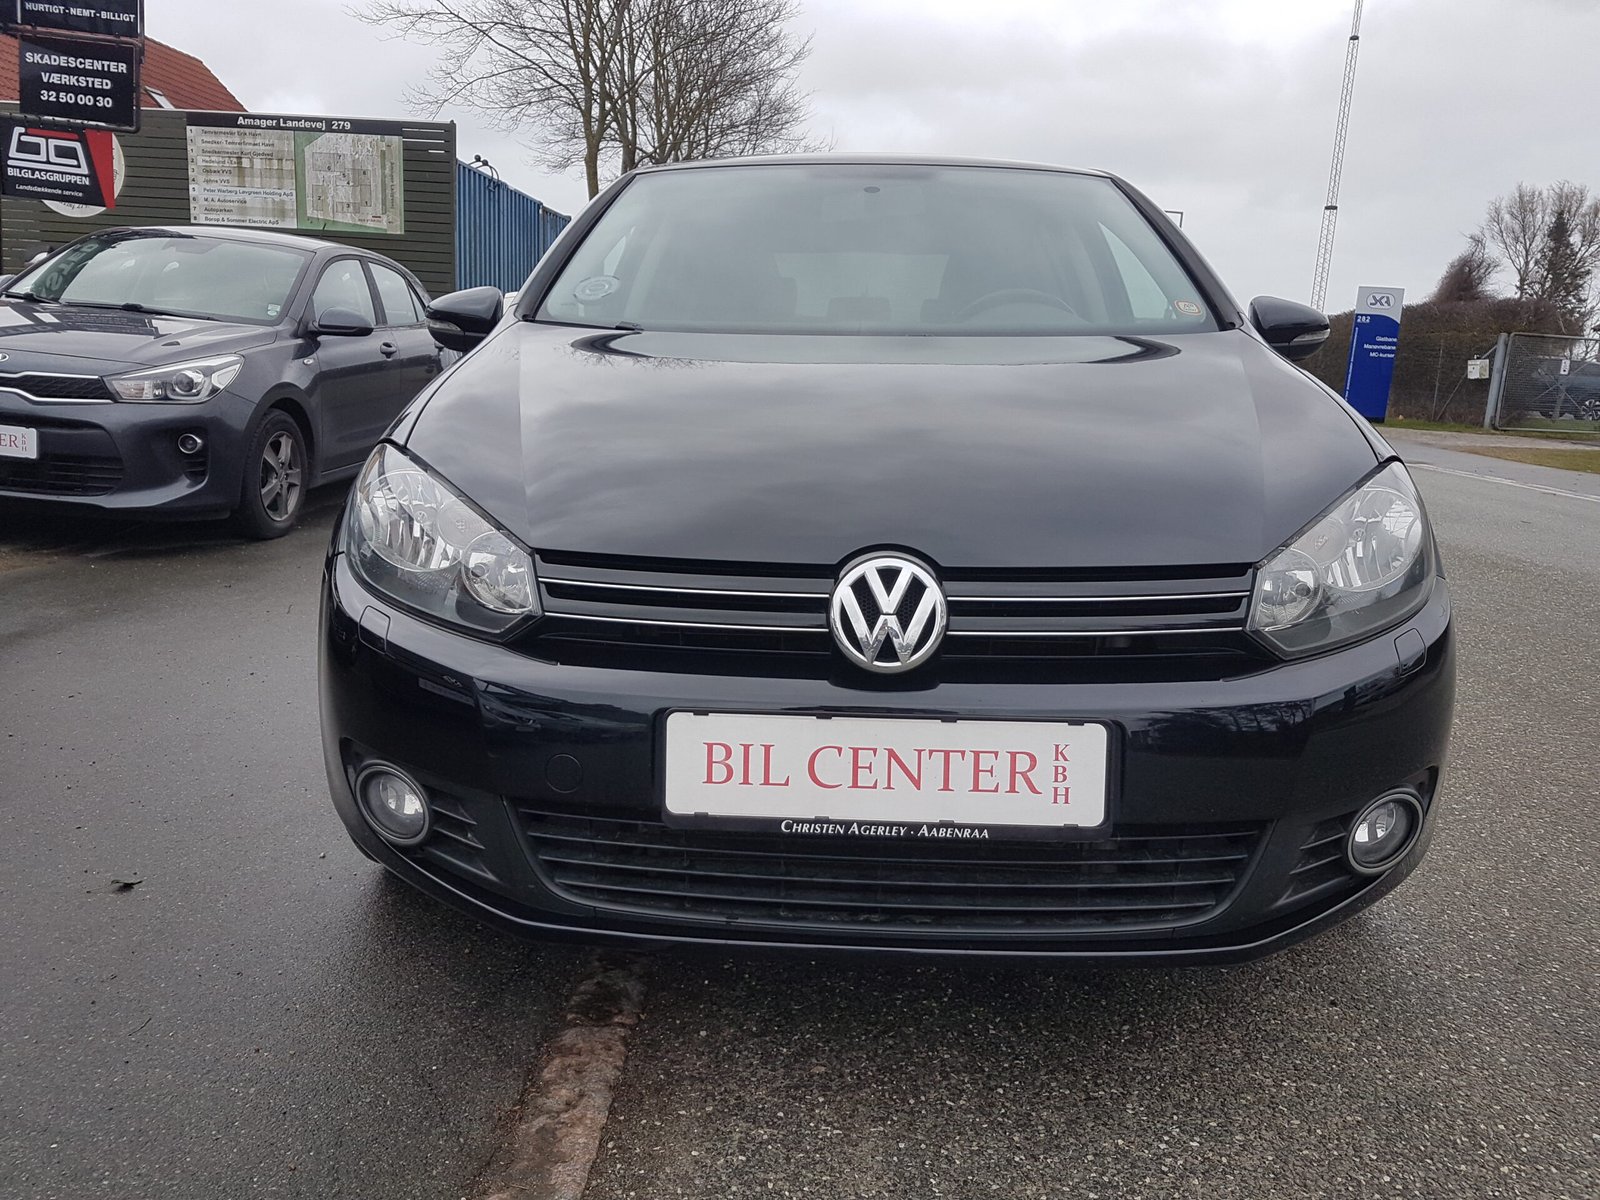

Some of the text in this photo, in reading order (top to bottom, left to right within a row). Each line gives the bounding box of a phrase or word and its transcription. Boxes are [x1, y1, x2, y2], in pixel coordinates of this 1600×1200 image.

[70, 8, 96, 18] NEMT
[101, 11, 135, 22] BILLIGT
[25, 52, 127, 73] SKADESCENTER
[41, 72, 111, 89] VÆRKSTED
[40, 90, 112, 108] 32 50 00 30
[237, 116, 350, 130] Amager Landevej 279
[7, 167, 90, 186] BILGLASGRUPPEN
[702, 741, 1071, 804] BIL CENTER KBH
[780, 819, 844, 837] CHRISTEN
[848, 822, 908, 837] AGERLEY
[917, 824, 990, 840] AABENRAA
